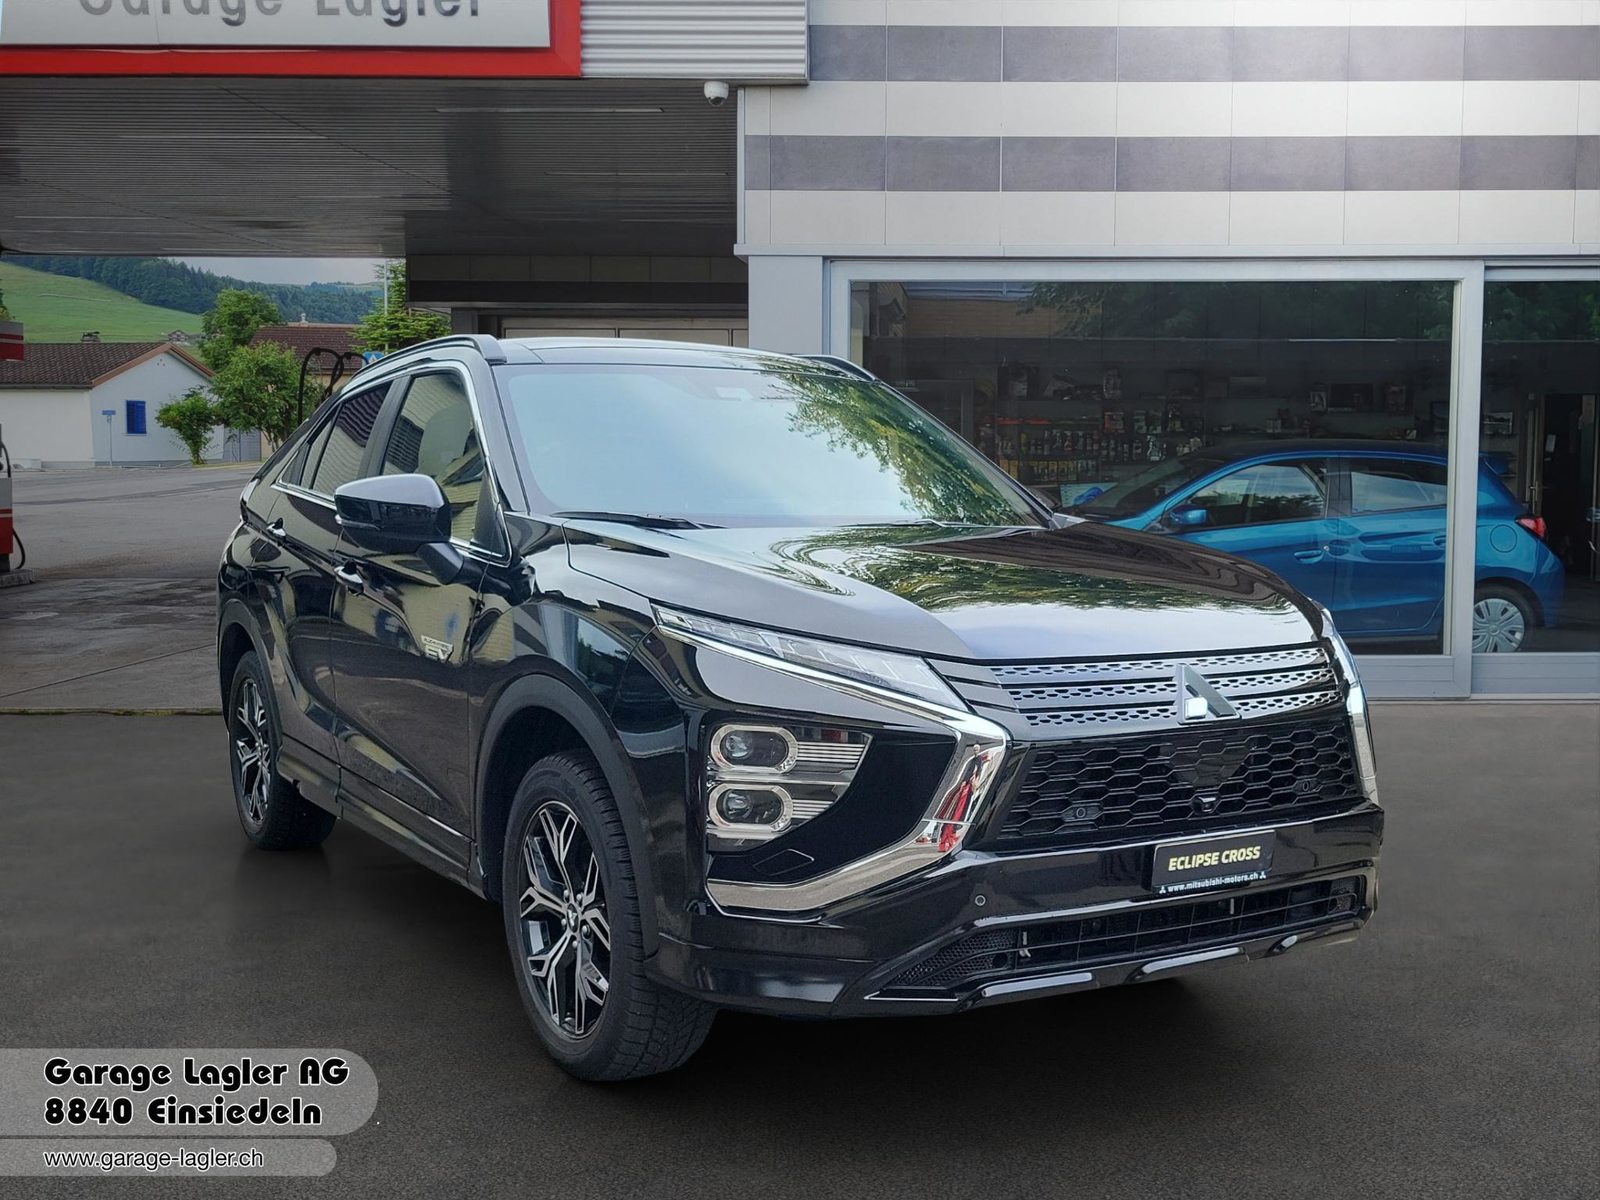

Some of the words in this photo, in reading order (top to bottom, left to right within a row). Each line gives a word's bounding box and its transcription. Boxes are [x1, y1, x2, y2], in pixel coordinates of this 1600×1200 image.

[1168, 852, 1220, 871] ECLIPSE
[1221, 846, 1261, 863] CROSS
[1167, 872, 1259, 892] www.mitsubishi-motors.ch
